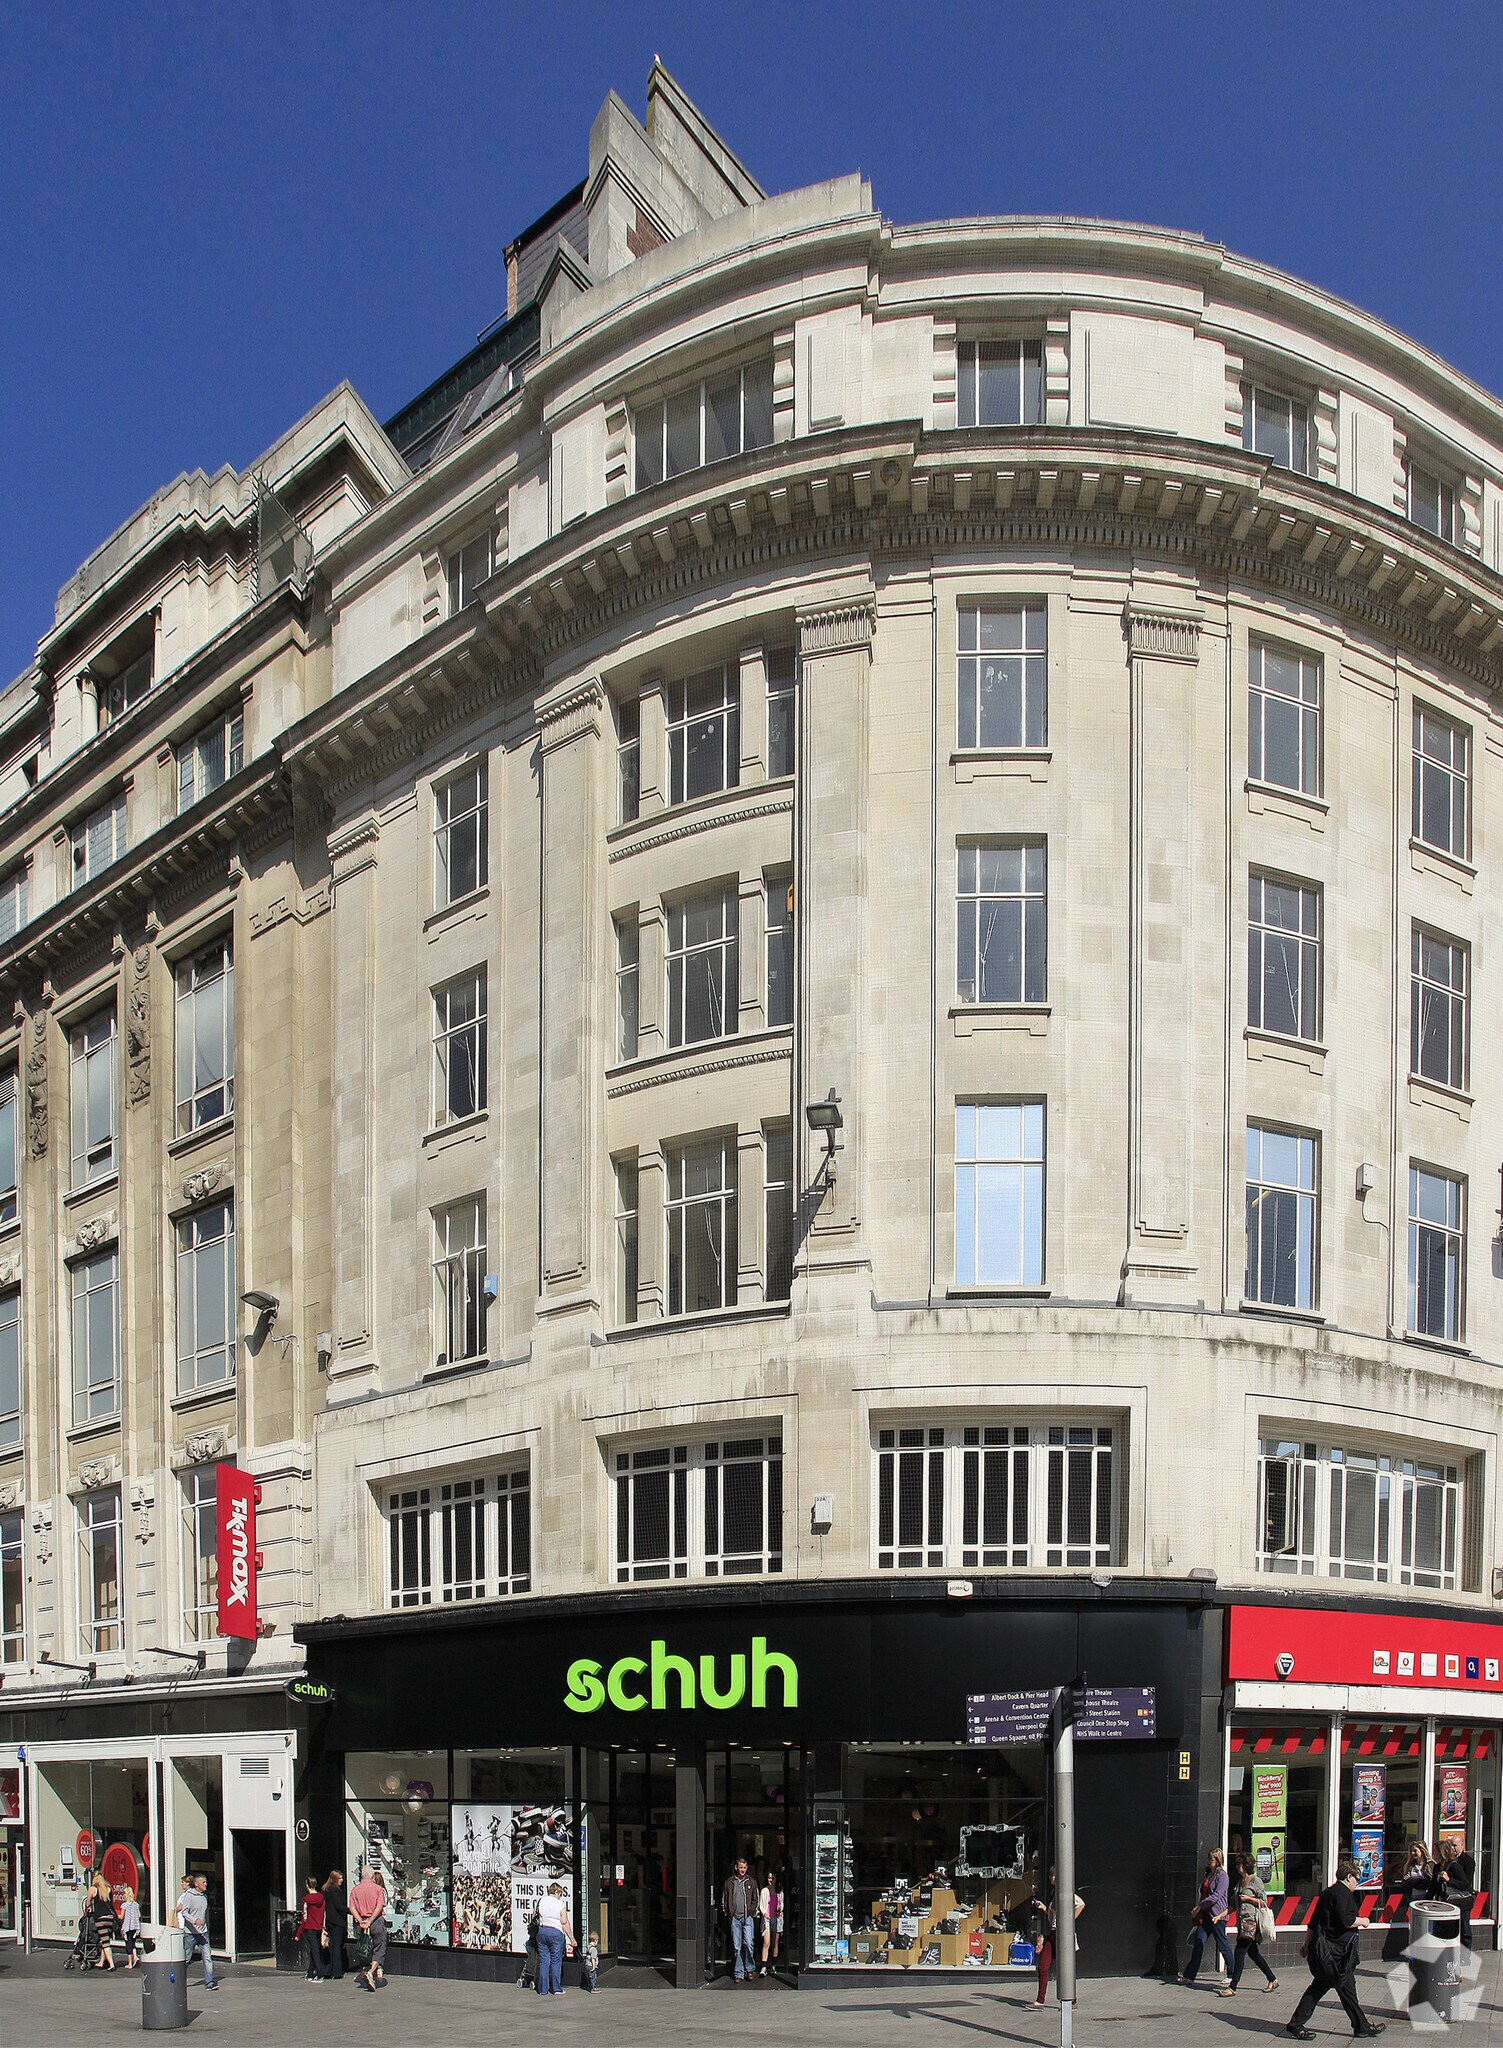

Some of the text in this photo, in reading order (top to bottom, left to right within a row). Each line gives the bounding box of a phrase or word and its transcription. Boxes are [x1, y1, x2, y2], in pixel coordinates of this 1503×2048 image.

[1488, 1662, 1495, 1677] 3
[563, 1636, 798, 1713] schuh
[294, 1682, 327, 1698] schuh
[1029, 1702, 1048, 1710] Quarter
[1005, 1713, 1032, 1721] Convention
[1015, 1723, 1038, 1731] Liverpool
[1117, 1719, 1129, 1727] Shop
[1106, 1729, 1122, 1737] Centre
[991, 1735, 1008, 1743] Queen
[1181, 1753, 1188, 1763] H
[1181, 1768, 1188, 1777] H
[515, 1884, 534, 1896] THIS
[536, 1884, 544, 1896] IS
[515, 1898, 531, 1909] THE
